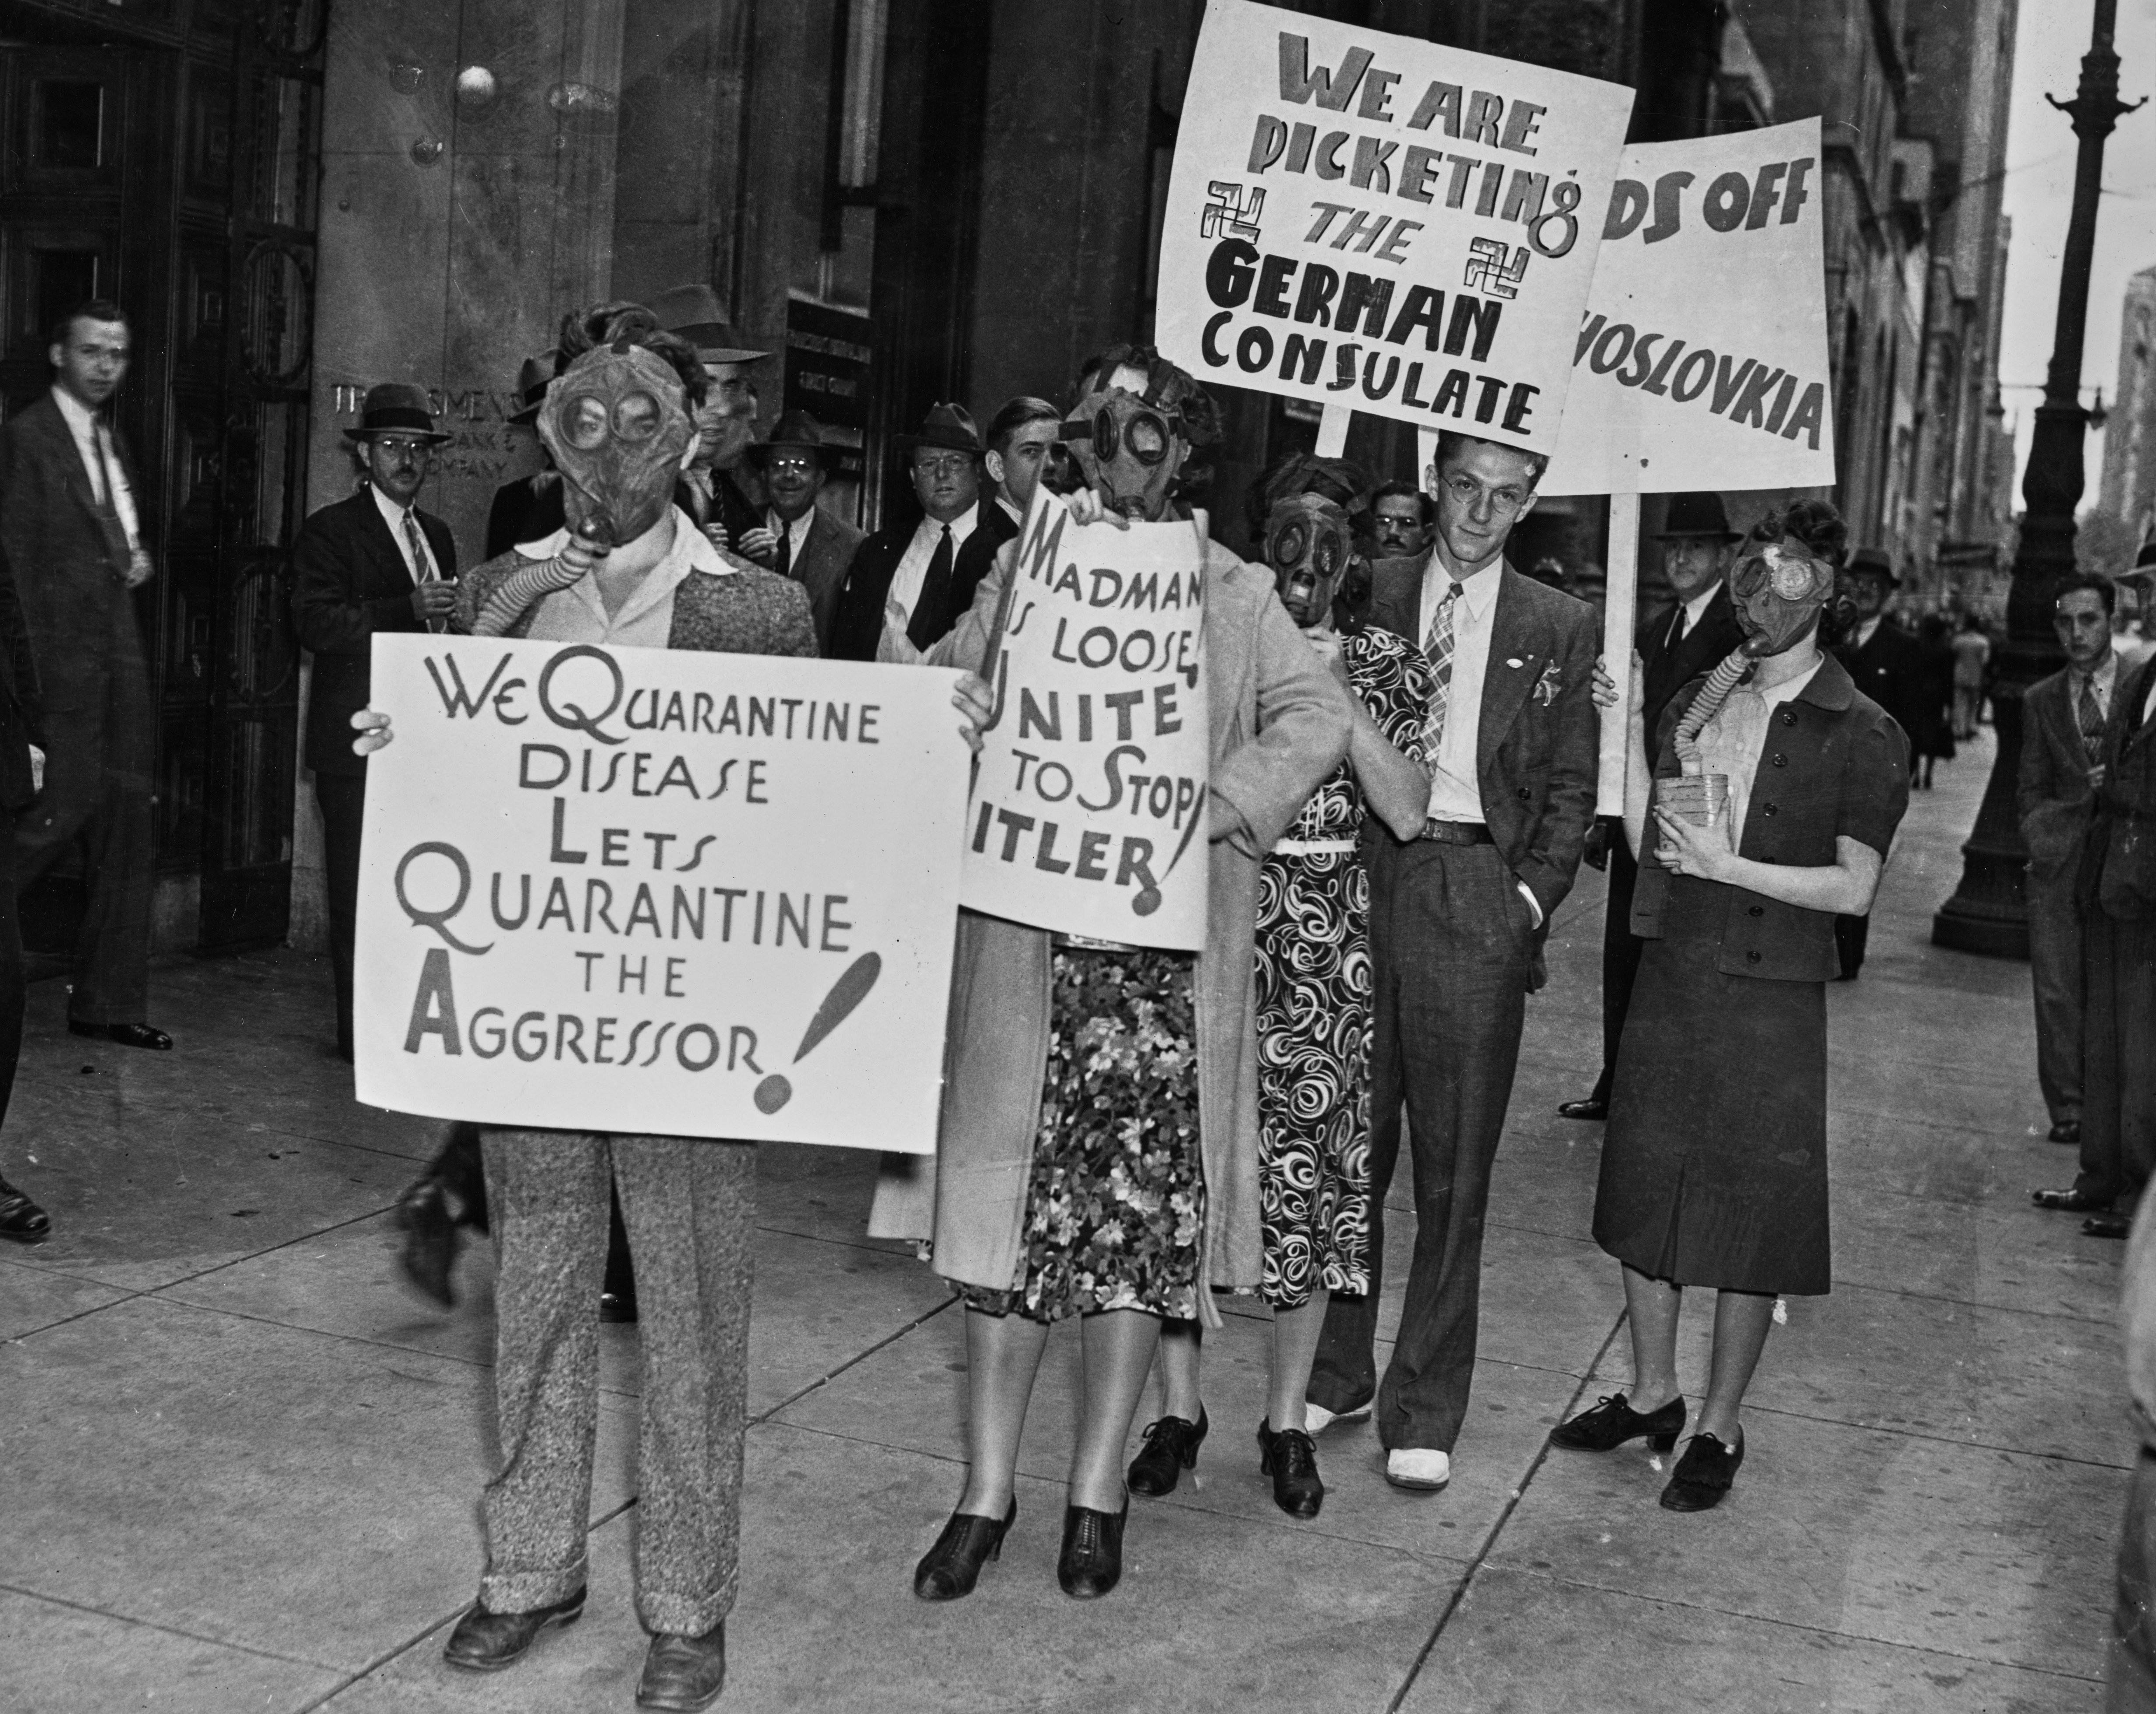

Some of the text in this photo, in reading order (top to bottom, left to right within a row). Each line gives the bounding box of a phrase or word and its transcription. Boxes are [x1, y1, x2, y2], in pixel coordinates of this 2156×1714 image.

[1279, 32, 1547, 157] WE ARE
[1304, 202, 1425, 265] THE
[1702, 157, 1816, 233] OFF
[1205, 238, 1503, 363] GERMAN
[1201, 310, 1541, 435] CONSULATE
[426, 459, 508, 480] OMPANY
[446, 429, 497, 451] ANK
[1019, 499, 1202, 613] MADMAN
[1052, 617, 1199, 690] LOOSE,
[538, 649, 881, 746] QUARANTINE
[518, 743, 769, 804] DISEASE
[1011, 745, 1195, 830] TO STOP
[550, 796, 717, 873] LETS
[966, 763, 1205, 917] ITLER!
[394, 841, 852, 956] QUARANTINE
[574, 951, 687, 998] THE
[403, 948, 882, 1115] AGGRESSOR!
